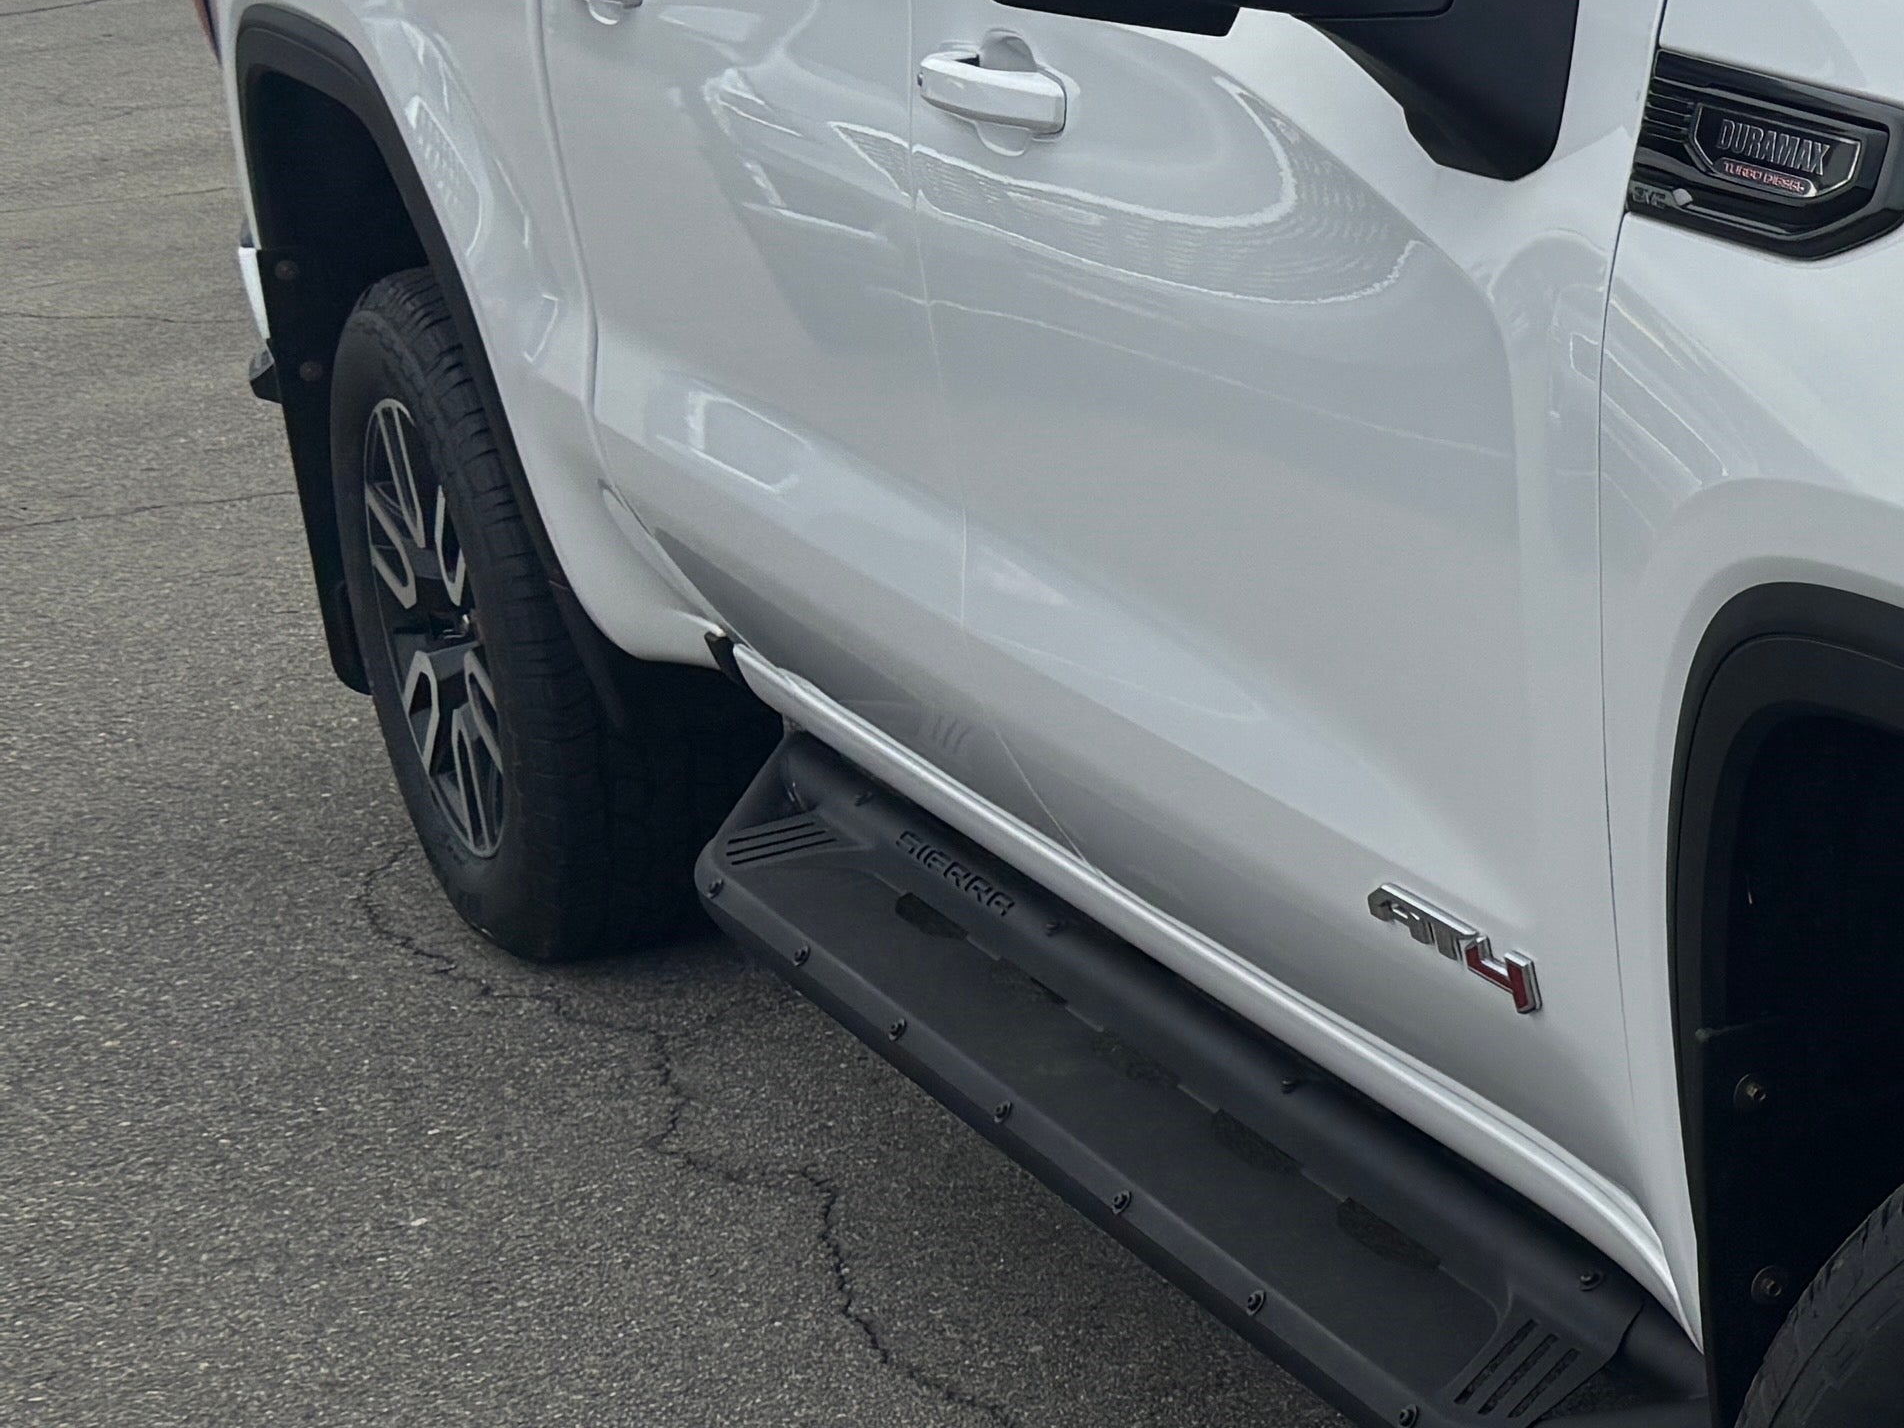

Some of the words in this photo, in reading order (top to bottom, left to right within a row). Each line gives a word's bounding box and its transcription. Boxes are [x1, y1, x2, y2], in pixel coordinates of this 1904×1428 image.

[1716, 118, 1831, 176] DURAMAX
[1723, 161, 1763, 180] TURBO
[1763, 172, 1805, 192] DIESEL
[896, 830, 1015, 917] SIERRA
[1368, 883, 1543, 1014] AT4
